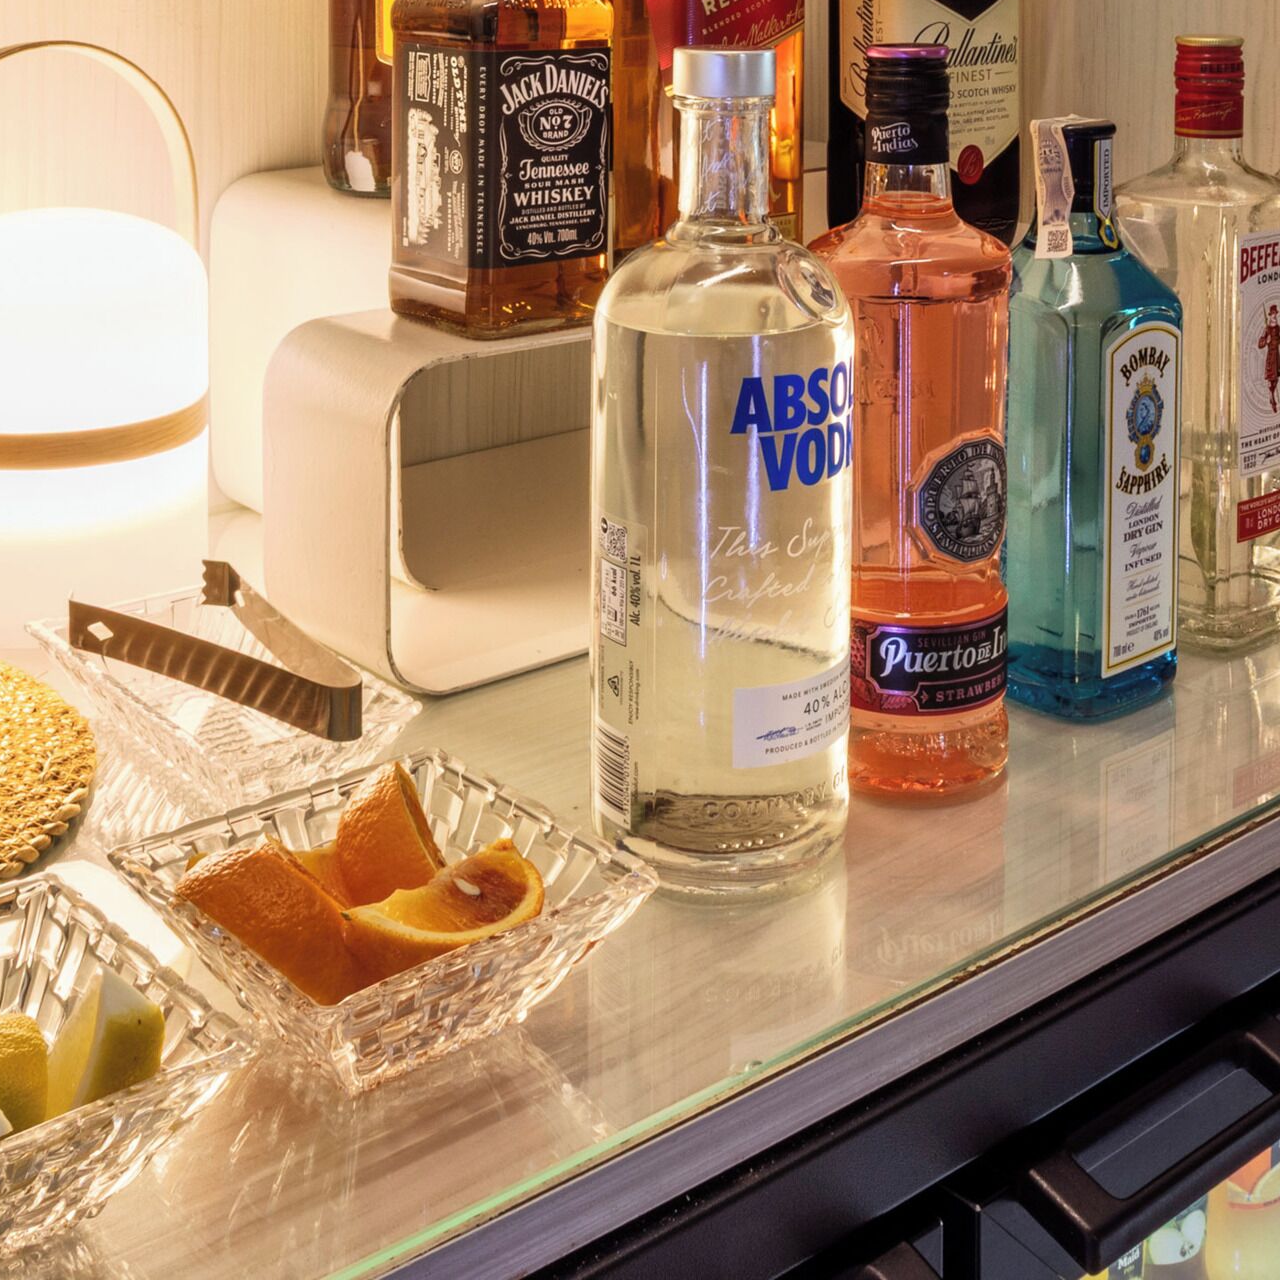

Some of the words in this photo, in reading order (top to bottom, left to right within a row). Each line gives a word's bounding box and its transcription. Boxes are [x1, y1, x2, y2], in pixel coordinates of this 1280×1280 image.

[701, 11, 742, 36] BLENDED
[450, 56, 461, 89] OLD
[479, 66, 487, 101] EVERY
[500, 71, 545, 115] JACK
[544, 64, 609, 110] DANIEL'S
[957, 87, 989, 99] SCOTCH
[991, 83, 1016, 95] WHISKY
[478, 105, 486, 134] DROP
[543, 130, 569, 139] BRAND
[871, 122, 911, 144] Puerto
[477, 138, 485, 169] MADE
[541, 154, 569, 163] QUALITY
[519, 159, 590, 181] Tennessee
[524, 182, 551, 190] SOUR
[555, 177, 585, 187] MASH
[513, 185, 594, 207] WHISKEY
[476, 191, 485, 255] TENNESSEE
[509, 216, 529, 225] JACK
[530, 213, 556, 223] DANIEL
[557, 209, 596, 220] DISTILLERY
[1119, 346, 1170, 387] BOMBAY
[1241, 441, 1253, 449] THE
[1254, 435, 1272, 445] HEART
[1272, 432, 1280, 440] OF
[1116, 453, 1172, 495] SAPPHIRE
[1124, 496, 1163, 521] Distilled
[1123, 528, 1144, 544] DRY
[1145, 520, 1164, 534] GIN
[1128, 513, 1160, 529] LONDON
[1257, 516, 1273, 530] DRY
[710, 526, 779, 560] This
[1125, 552, 1162, 572] INFUSED
[630, 569, 640, 586] vol.
[705, 564, 816, 609] Crafted
[629, 587, 641, 608] 40%
[629, 610, 640, 627] Alc.
[918, 635, 970, 648] SEVILLIAN
[972, 630, 986, 642] GIN
[879, 636, 978, 677] Puerto
[977, 642, 992, 664] DE
[782, 692, 802, 701] MADE
[803, 686, 819, 695] WITH
[765, 742, 803, 754] PRODUCED
[809, 728, 831, 744] BOTTLED
